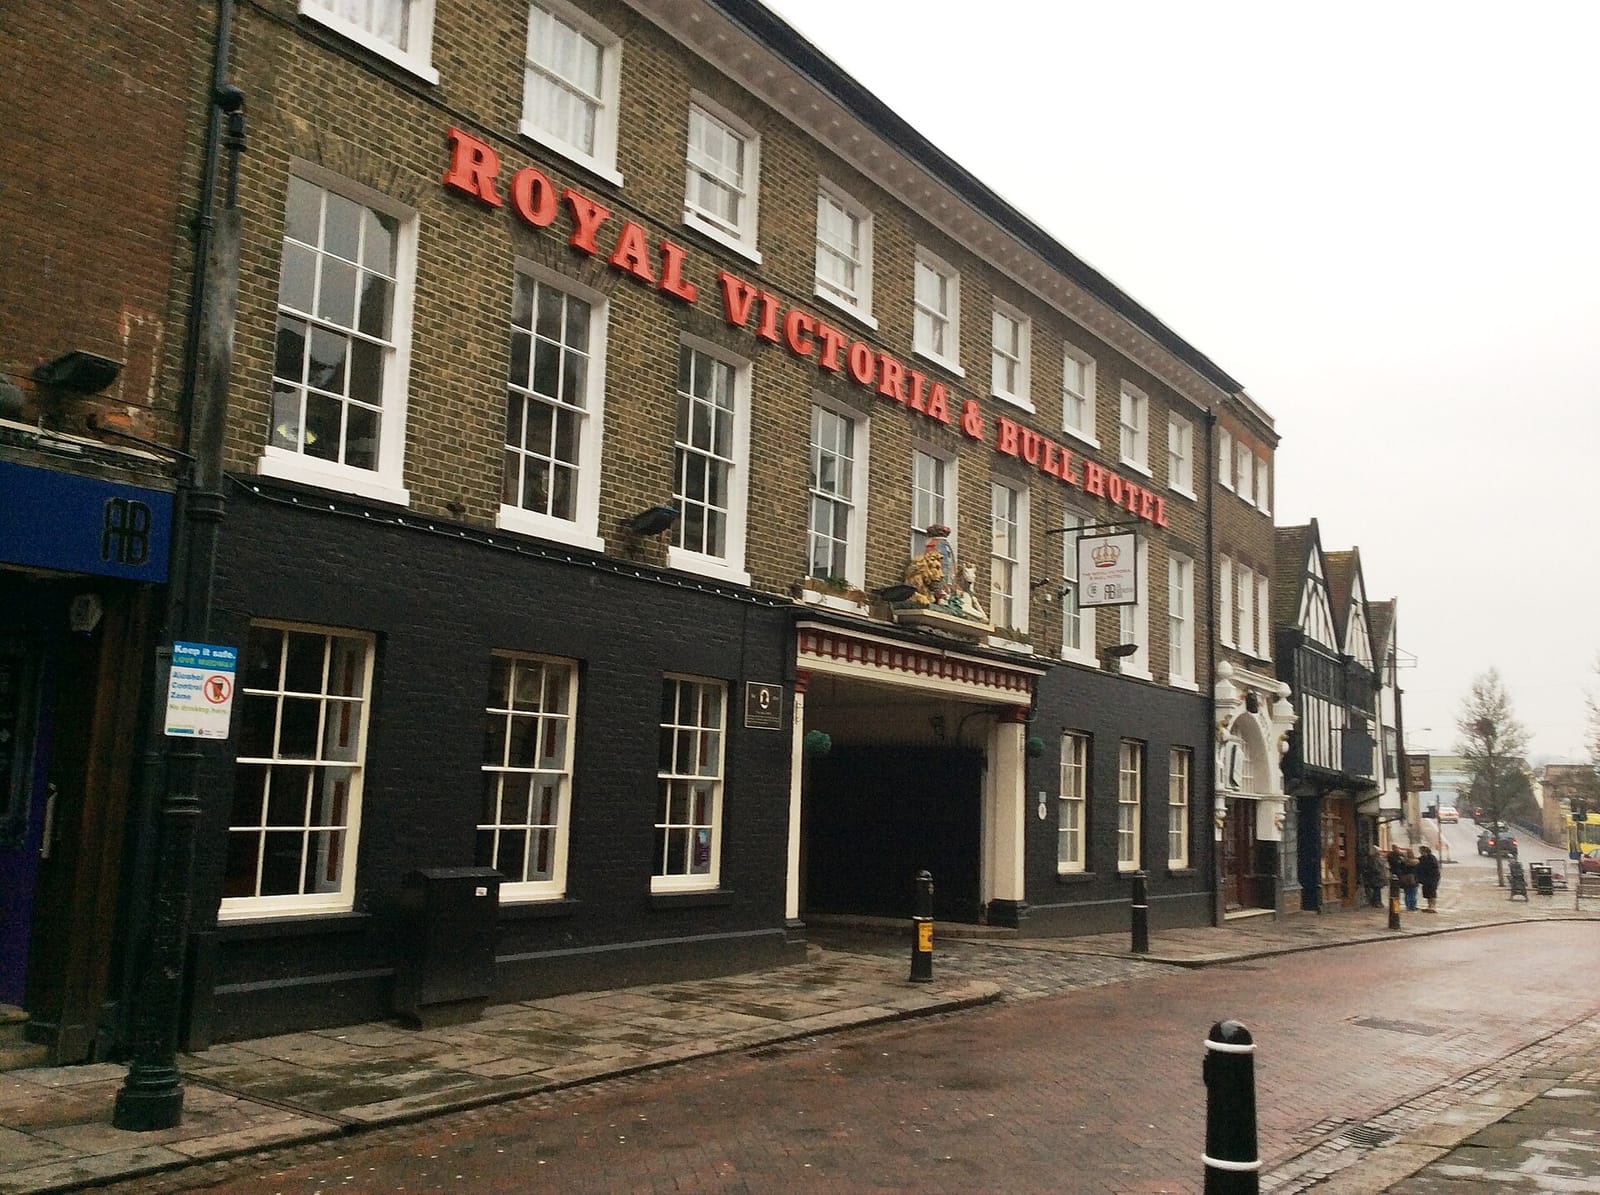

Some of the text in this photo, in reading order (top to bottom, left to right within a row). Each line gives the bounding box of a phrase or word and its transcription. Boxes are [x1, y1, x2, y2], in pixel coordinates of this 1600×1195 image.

[443, 127, 1169, 528] ROYAL VICTORIA & BULL HOTEL
[174, 645, 200, 656] Keep
[202, 648, 210, 656] it
[172, 671, 204, 681] Alcohol
[170, 691, 191, 700] Zone
